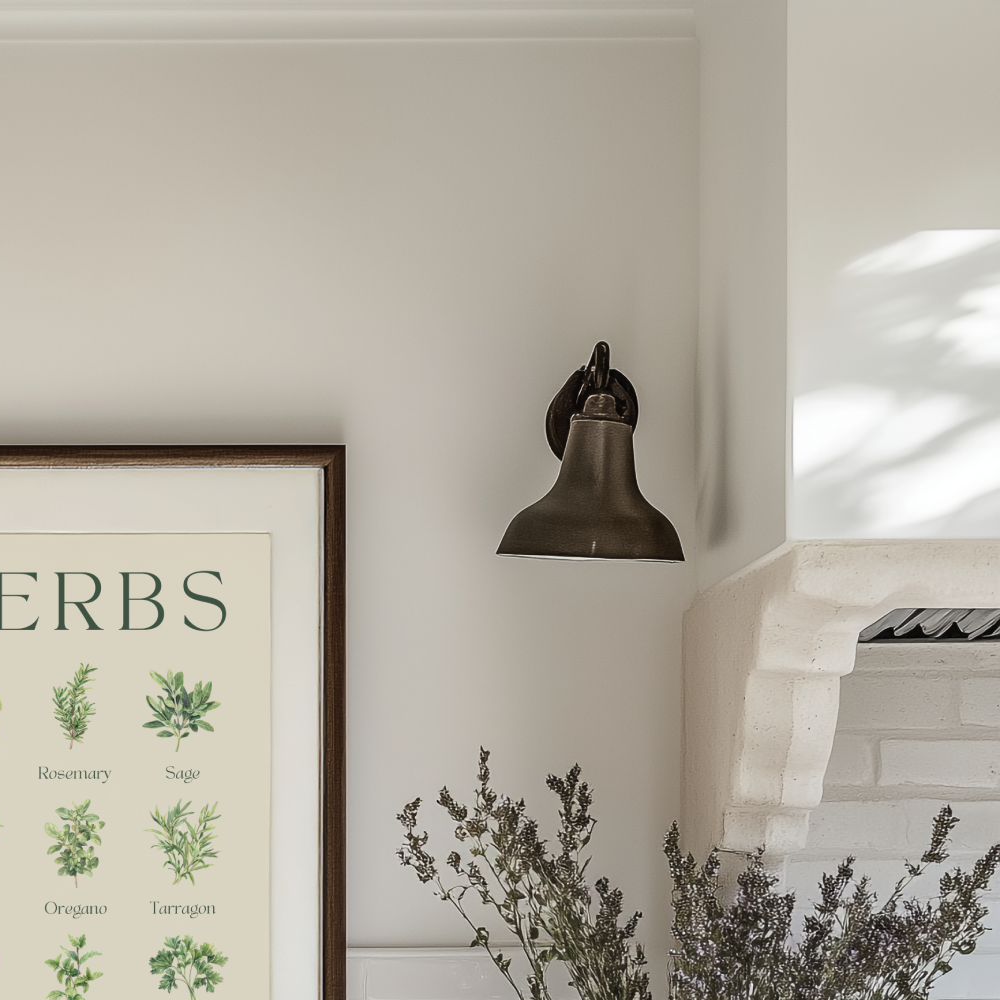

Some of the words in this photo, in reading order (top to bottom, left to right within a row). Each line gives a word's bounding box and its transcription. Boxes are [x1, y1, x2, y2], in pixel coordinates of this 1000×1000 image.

[37, 765, 112, 784] Rosemary
[165, 765, 201, 784] Sage
[44, 901, 108, 920] Oregano
[149, 900, 216, 919] Tarragon
